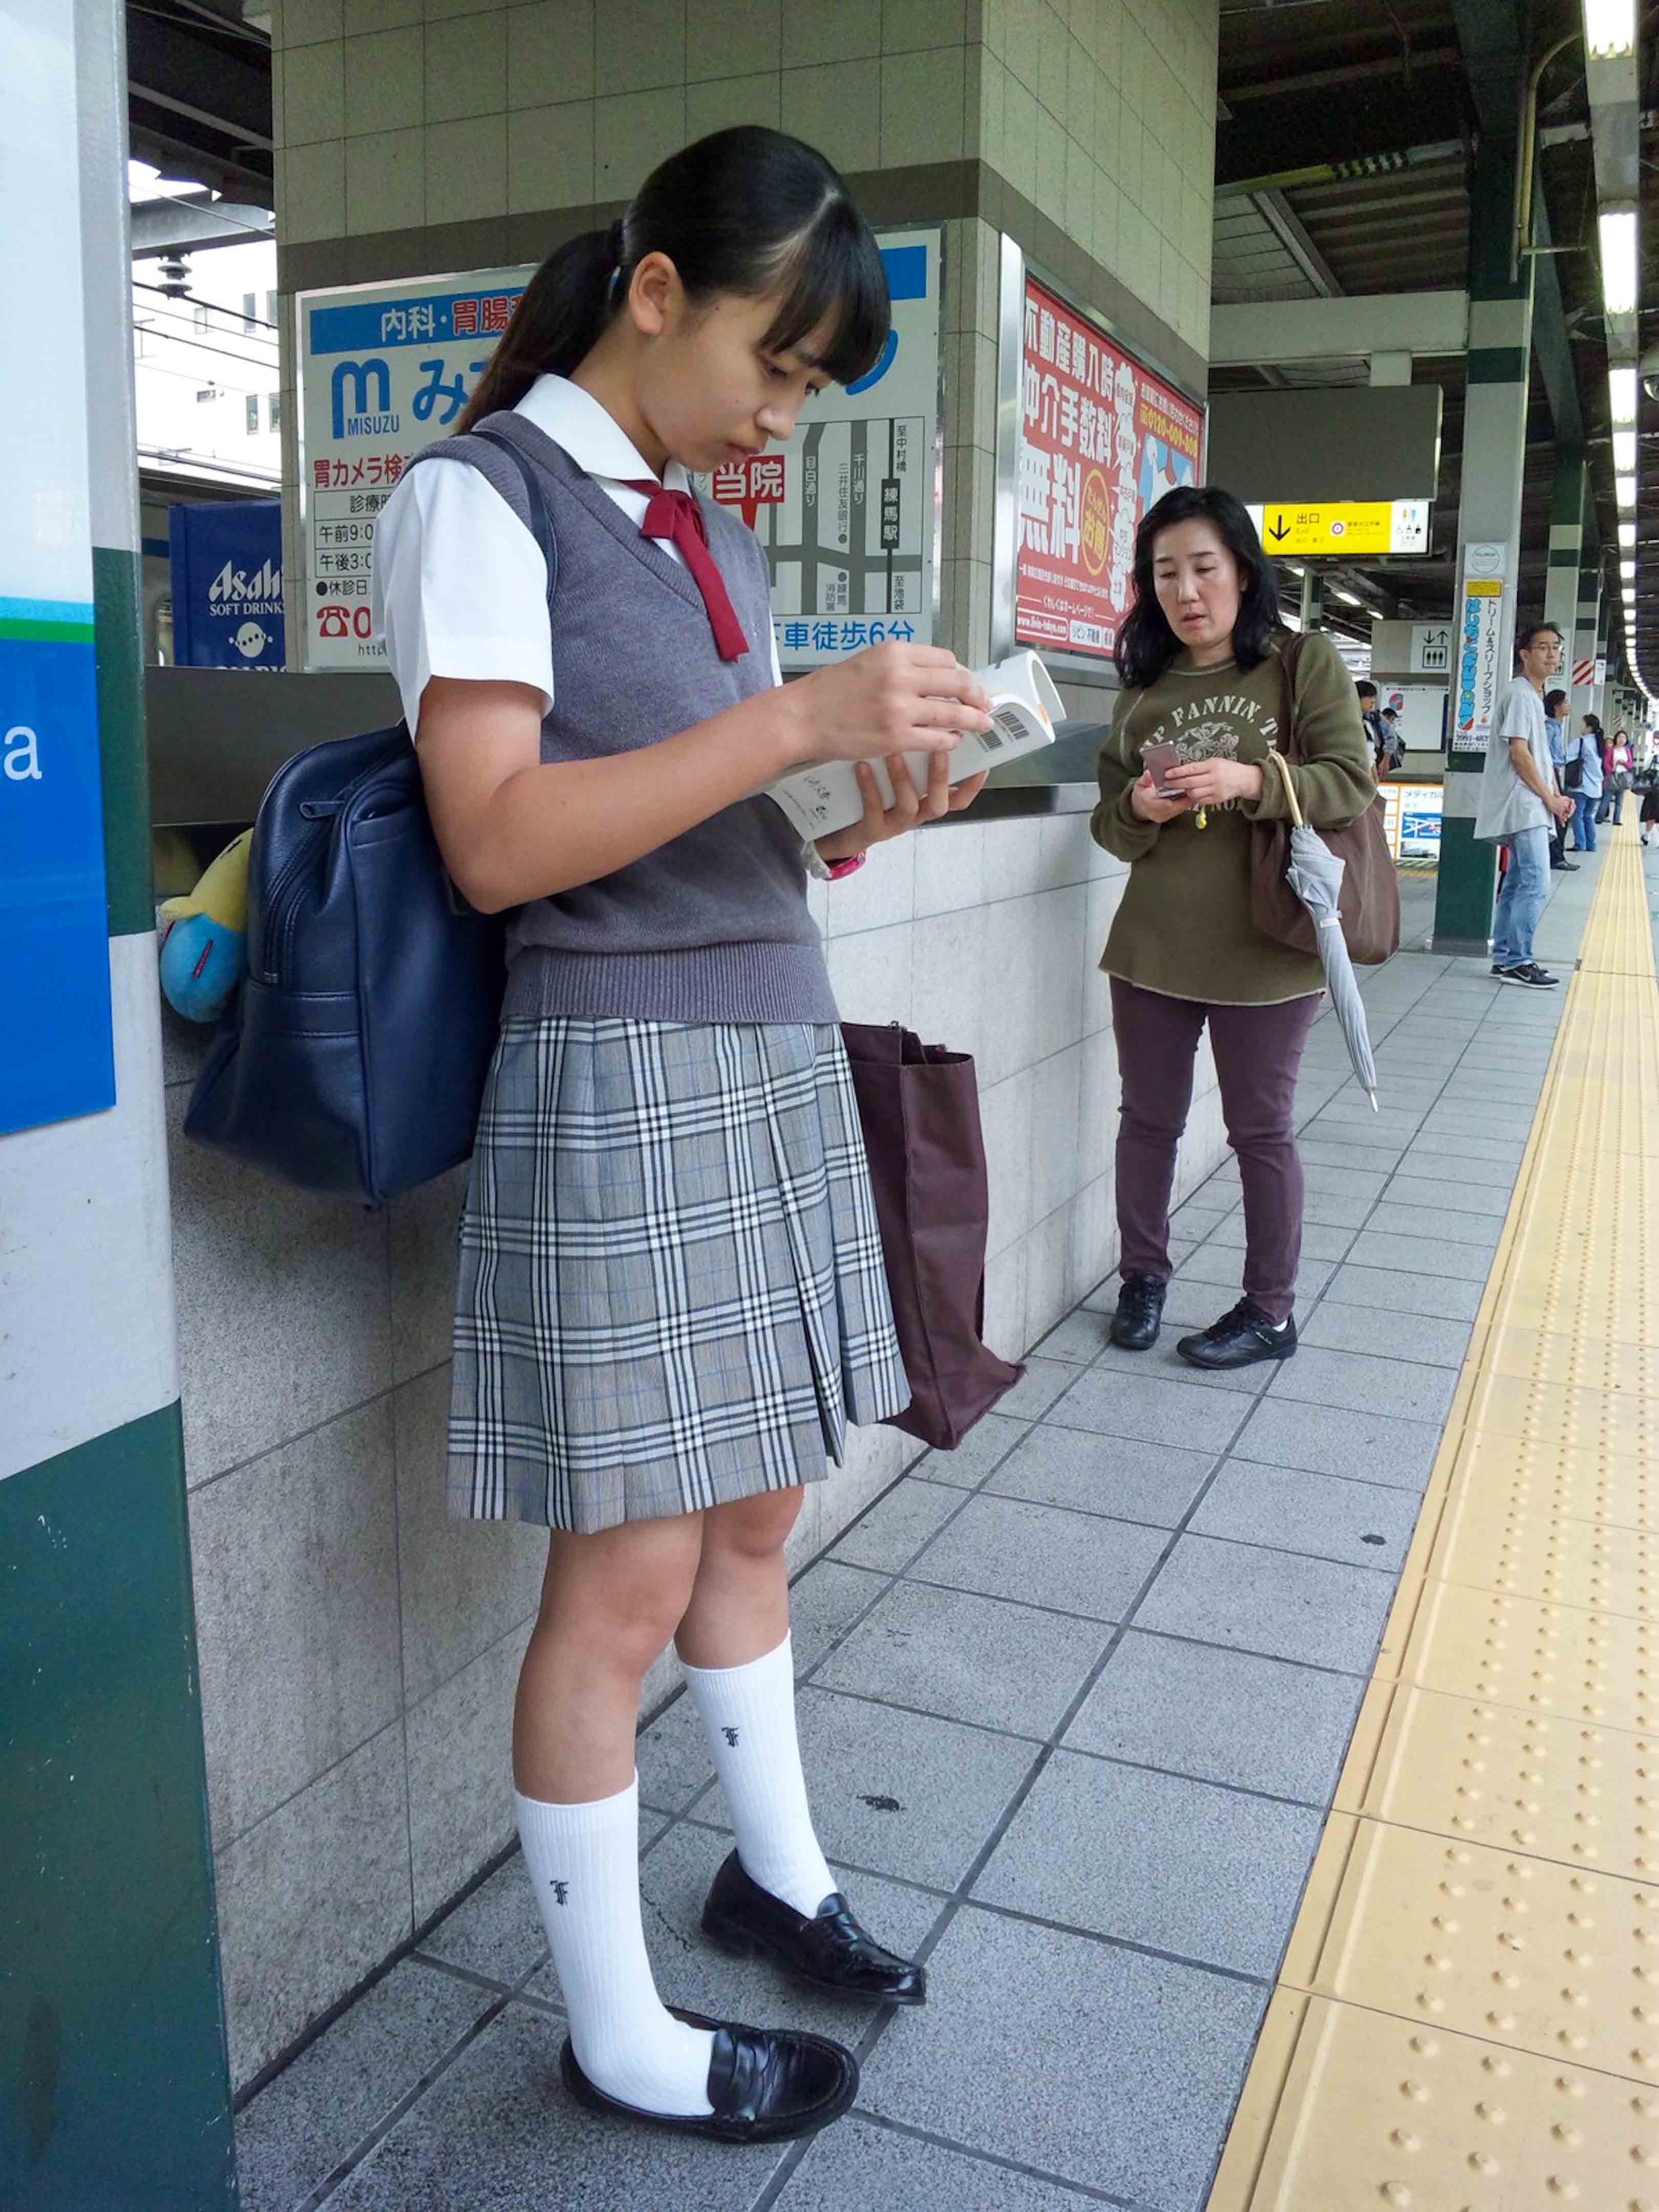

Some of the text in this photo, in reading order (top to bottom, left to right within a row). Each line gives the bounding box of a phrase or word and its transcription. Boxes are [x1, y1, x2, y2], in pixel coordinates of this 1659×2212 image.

[381, 294, 523, 342] 内科・胃腸
[413, 359, 490, 425] み
[348, 414, 400, 436] MISUZU
[1024, 359, 1112, 468] 仲介手数料
[314, 454, 410, 489] 胃カメラ検
[715, 461, 782, 500] 当院
[883, 486, 899, 541] 練馬駅
[1017, 441, 1080, 565] 無料
[1296, 513, 1320, 524] 出口
[209, 558, 284, 602] Asah
[210, 603, 241, 616] SOFT
[1171, 695, 1262, 728] FANNIN,
